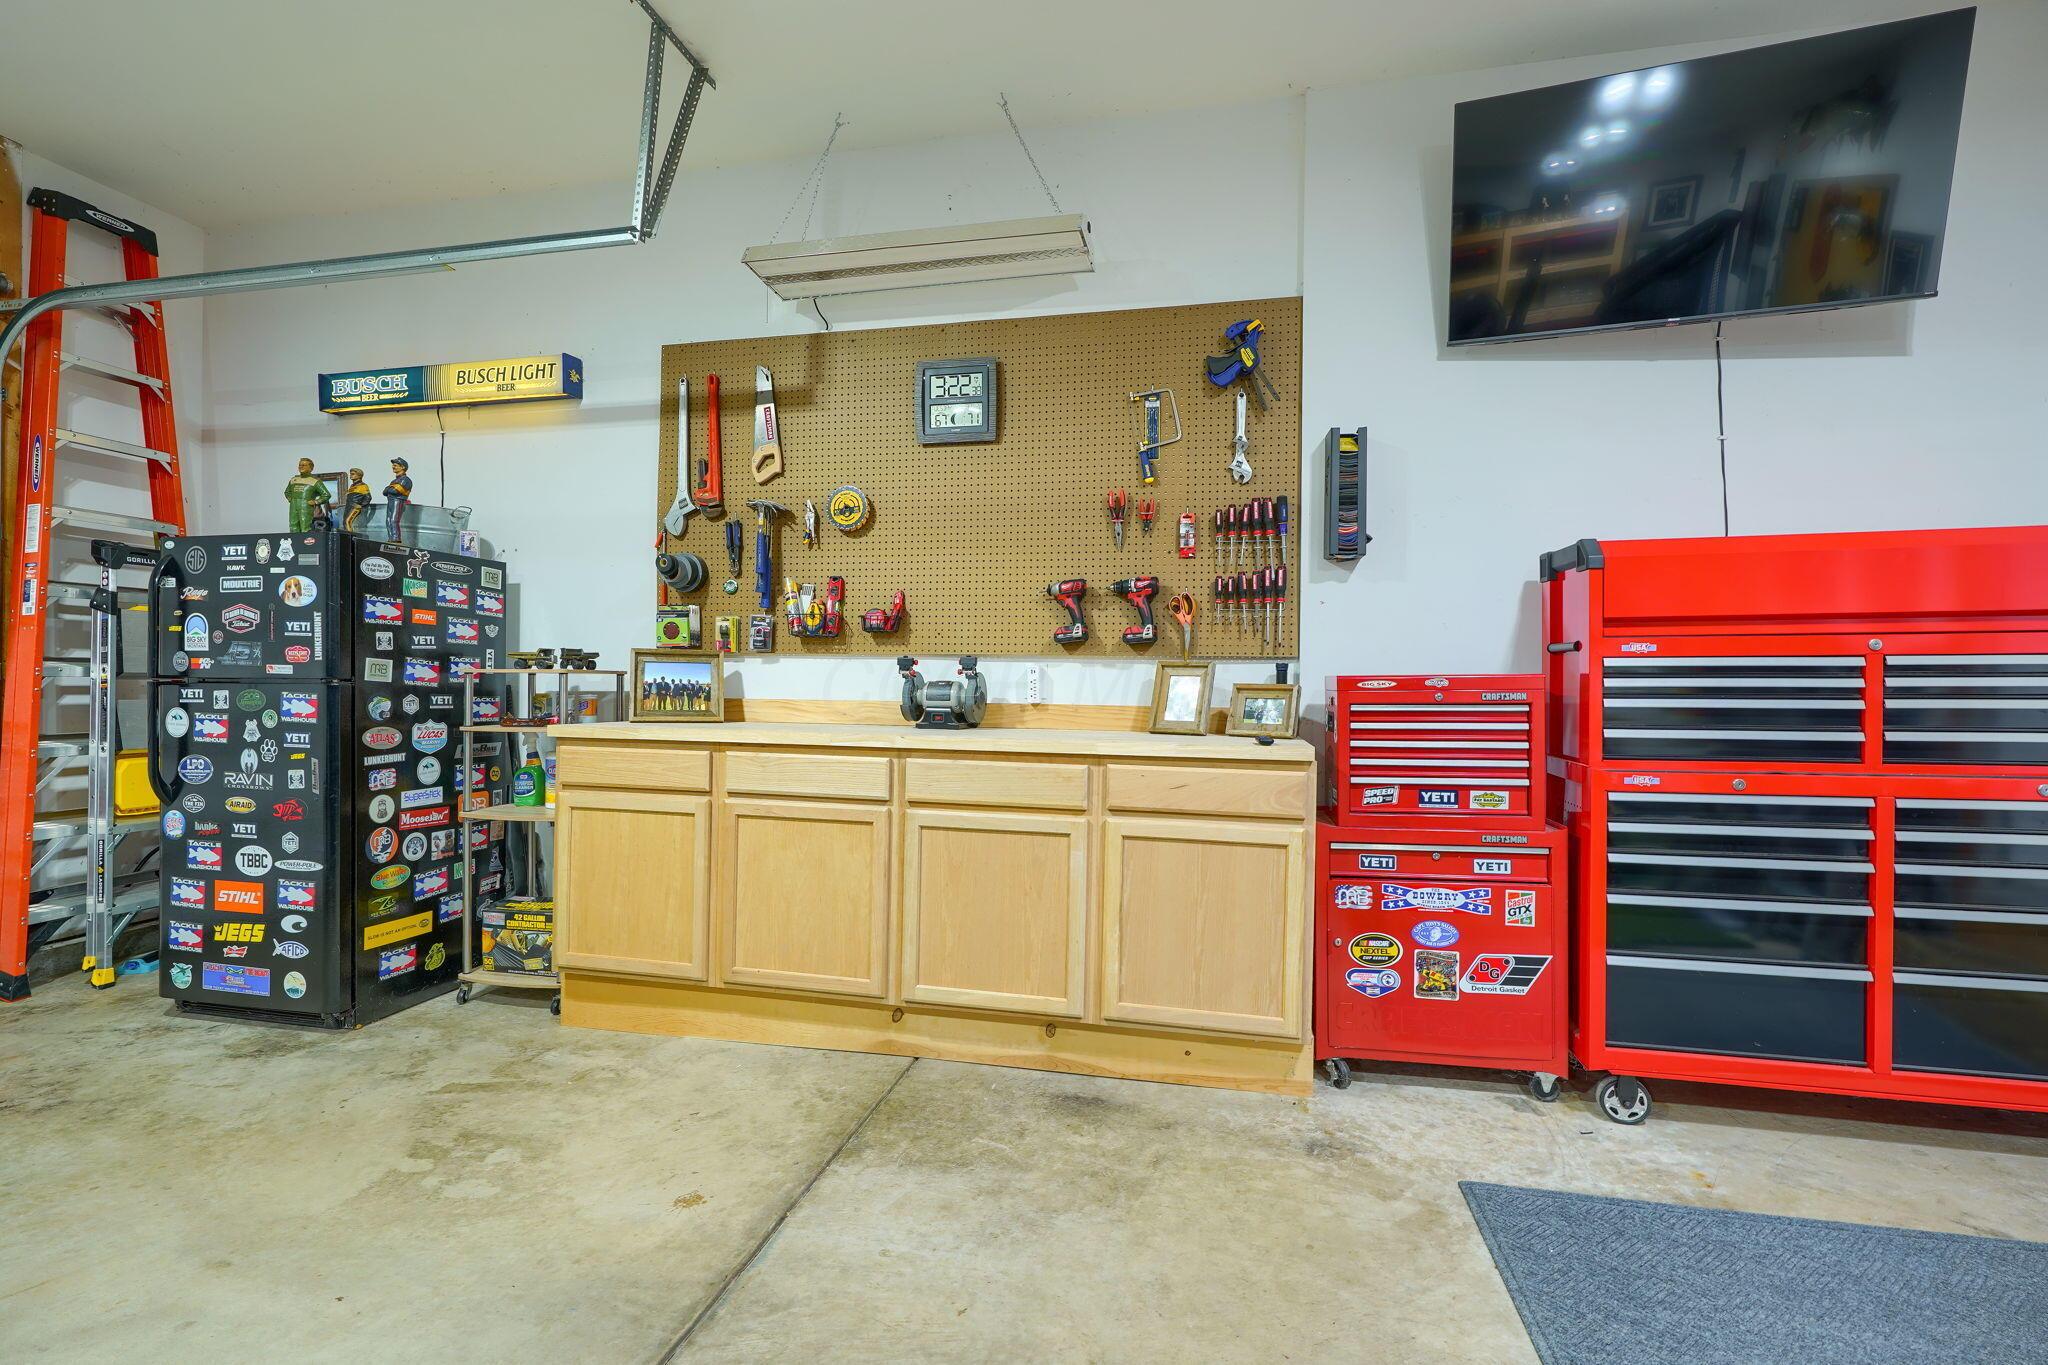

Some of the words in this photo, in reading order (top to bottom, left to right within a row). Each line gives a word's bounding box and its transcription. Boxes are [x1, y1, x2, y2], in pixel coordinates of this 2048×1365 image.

[456, 367, 509, 386] BUSCH
[510, 362, 557, 382] LIGHT
[331, 373, 409, 397] BUSCH
[496, 383, 516, 393] BEER
[935, 374, 972, 398] 3:22
[934, 414, 948, 427] 67
[33, 446, 41, 481] WERNER
[222, 545, 246, 556] YETI
[126, 556, 157, 565] GORILLA
[187, 549, 205, 571] SIG
[222, 579, 260, 589] MOULTRIE
[436, 579, 468, 588] TACKLE
[475, 588, 504, 598] TACKLE
[364, 593, 403, 604] TACKLE
[436, 601, 469, 610] WAREHOUSE
[363, 617, 402, 626] WAREHOUSE
[413, 613, 435, 622] STIHL
[447, 616, 479, 625] TACKLE
[285, 621, 311, 632] YETI
[313, 611, 322, 661] LUNKERHUNT
[412, 635, 435, 645] YETI
[405, 656, 440, 666] TACKLE
[486, 649, 494, 670] YET
[404, 679, 439, 688] WAREHOUSE
[181, 688, 204, 698] YETI
[281, 691, 318, 700] TACKLE
[1481, 692, 1527, 701] CRAFTSMAN
[430, 695, 453, 704] YETI
[194, 712, 229, 720] TACKLE
[280, 716, 317, 724] WAREHOUSE
[285, 733, 310, 743] YETI
[417, 730, 445, 739] LUCAS
[193, 736, 228, 744] WAREHOUSE
[186, 758, 205, 770] LPO
[364, 752, 407, 766] LUNKERHUNT
[224, 772, 274, 786] RAVIN
[1364, 788, 1394, 798] SPEED
[1421, 791, 1456, 803] YETI
[228, 800, 253, 809] AIRAID
[1363, 796, 1383, 805] PRO
[232, 823, 256, 834] YETI
[187, 839, 222, 848] TACKLE
[1481, 835, 1528, 844] CRAFTSMAN
[240, 852, 268, 869] TBBC
[1361, 856, 1393, 868] YETI
[187, 864, 222, 872] WAREHOUSE
[1475, 861, 1508, 872] YETI
[413, 865, 448, 879] TACKLE
[171, 876, 206, 887] TACKLE
[278, 878, 316, 888] TACKLE
[217, 890, 259, 905] STIHL
[414, 888, 448, 902] WAREHOUSE
[440, 892, 464, 902] TACKL
[1412, 891, 1459, 901] BOWERY
[170, 900, 205, 910] WAREHOUSE
[1507, 896, 1534, 908] Castrol
[277, 903, 315, 912] WAREHOUSE
[1507, 904, 1532, 917] GTX
[439, 913, 464, 924] WAREHO
[513, 913, 523, 921] 42
[523, 914, 546, 922] GALLON
[169, 921, 204, 930] TACKLE
[506, 920, 546, 929] CONTRACTOR
[214, 922, 266, 943] JEGS
[168, 943, 204, 953] WAREHOUSE
[380, 943, 417, 958] TACKLE
[1360, 947, 1390, 955] NEXTEL
[379, 966, 416, 981] WAREHOUSE
[1499, 986, 1526, 994] Gasket
